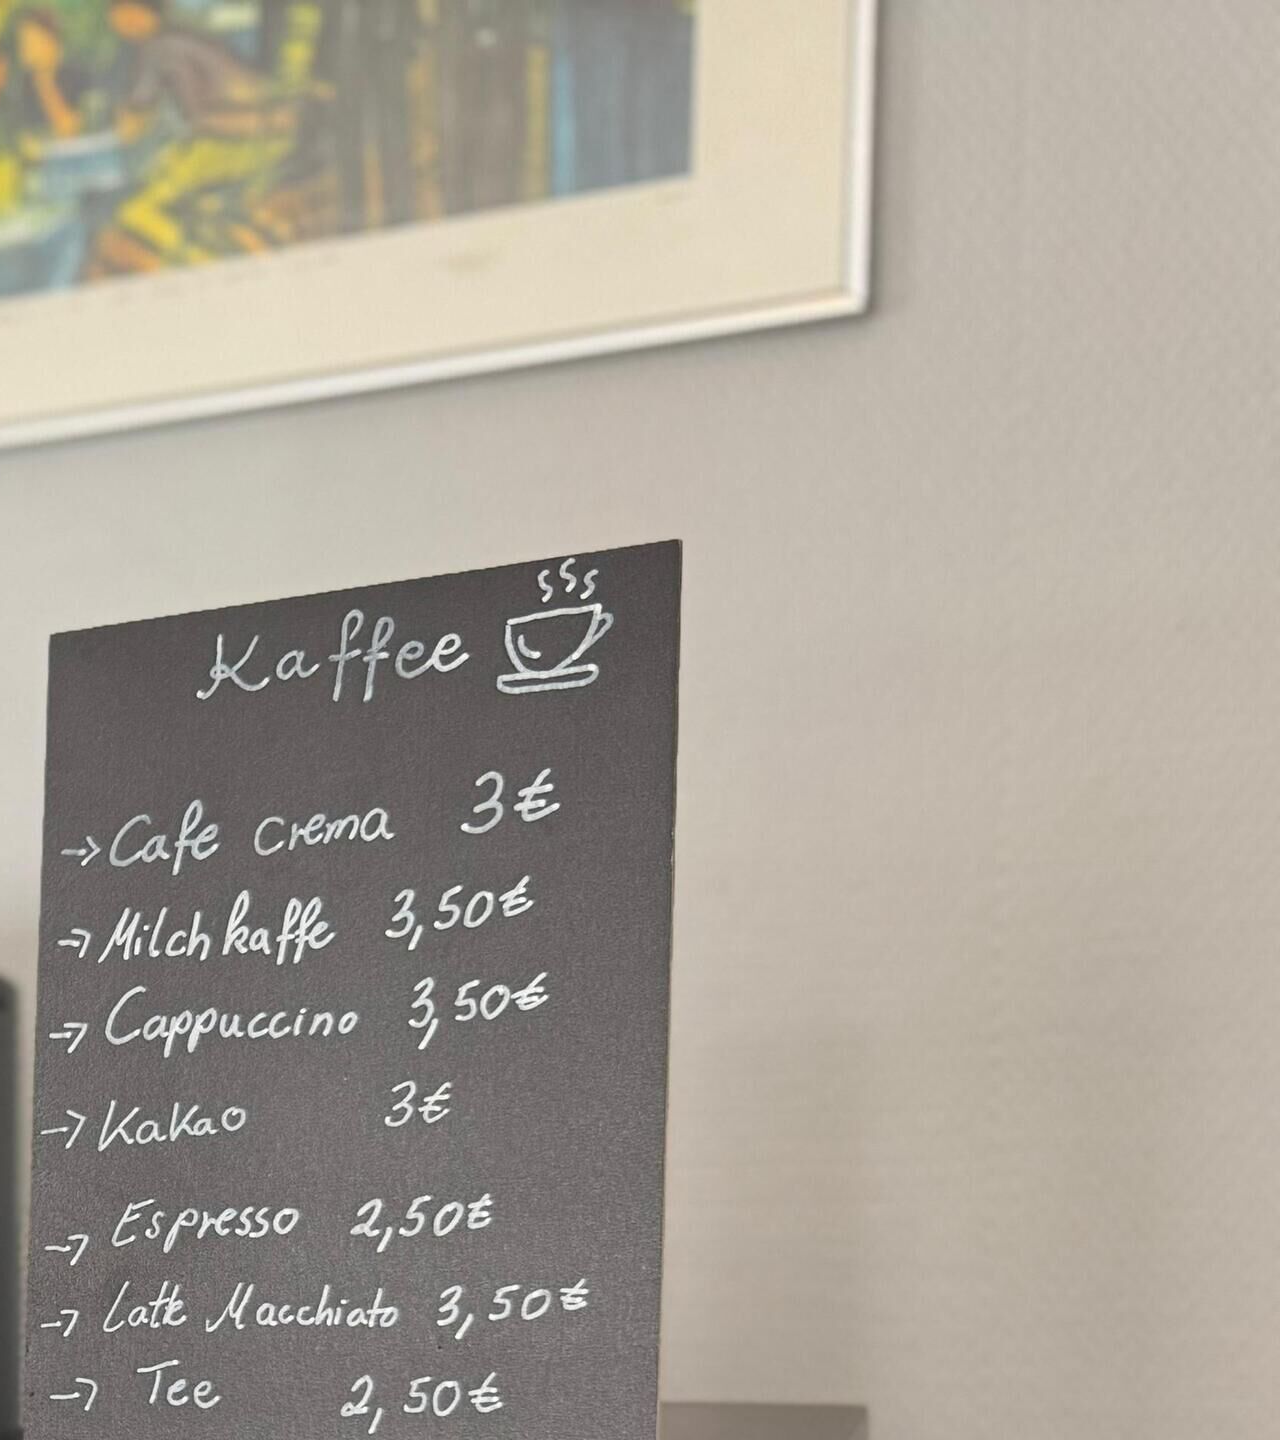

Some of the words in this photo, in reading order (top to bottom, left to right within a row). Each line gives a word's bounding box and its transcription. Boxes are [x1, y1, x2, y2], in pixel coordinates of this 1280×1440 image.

[195, 607, 471, 702] Kaffee
[460, 767, 561, 834] 3€
[384, 875, 534, 951] 3,50€
[104, 985, 359, 1058] Cappuccino
[408, 971, 549, 1051] 3,50€
[384, 1080, 452, 1127] 3€
[111, 1198, 300, 1254] Espresso
[349, 1192, 494, 1253] 2,50€
[205, 1282, 399, 1333] Macchiato
[436, 1278, 590, 1340] 3,50€
[136, 1359, 221, 1409] Tee
[340, 1371, 504, 1435] 2,50€
